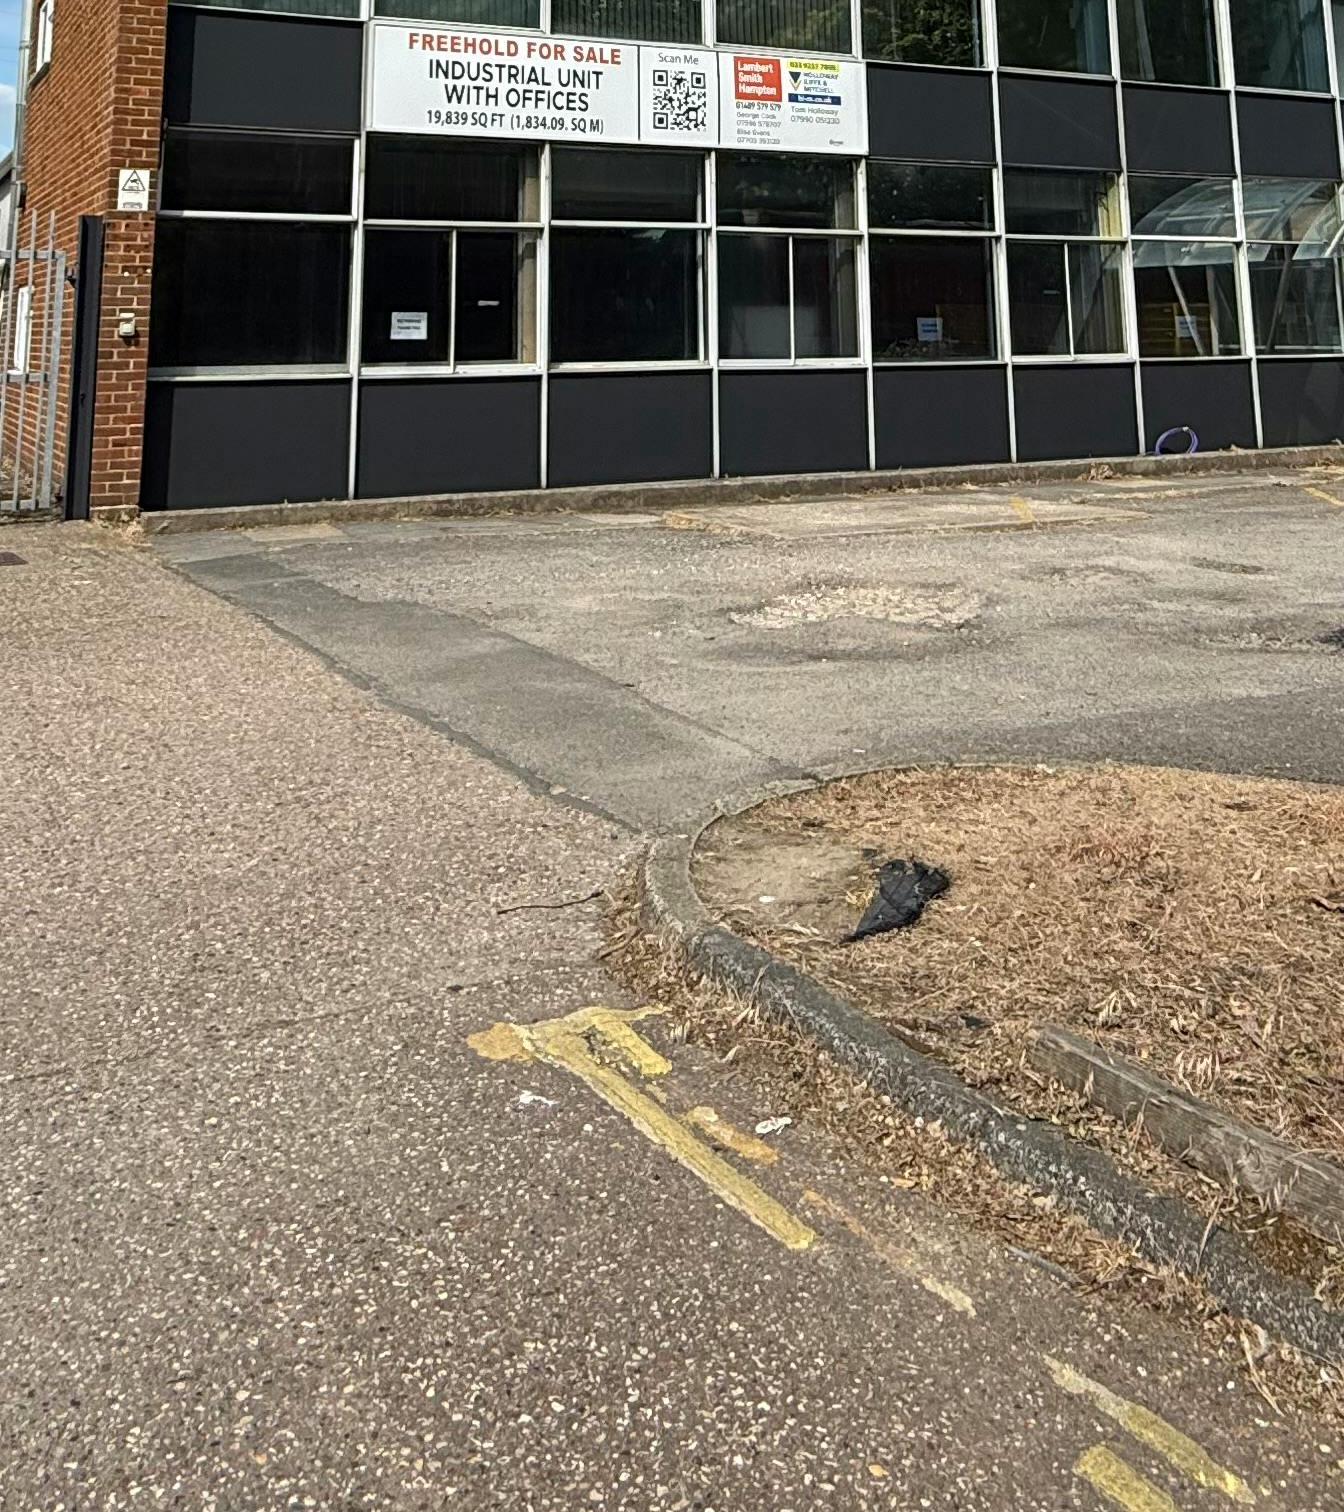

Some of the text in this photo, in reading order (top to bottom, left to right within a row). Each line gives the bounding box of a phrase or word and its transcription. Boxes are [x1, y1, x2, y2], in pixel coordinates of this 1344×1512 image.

[408, 33, 621, 65] FREEHOLD FOR SALE
[658, 52, 699, 65] Scan Me
[738, 61, 773, 73] Lambert
[429, 59, 603, 89] INDUSTRIAL UNIT
[738, 72, 763, 83] Smith
[738, 83, 777, 96] Hampton
[444, 83, 589, 112] WITH OFFICES
[756, 102, 769, 110] 579
[769, 103, 782, 111] 579
[427, 110, 604, 135] 19,839 SQ FT (1,834.09. SQ M)
